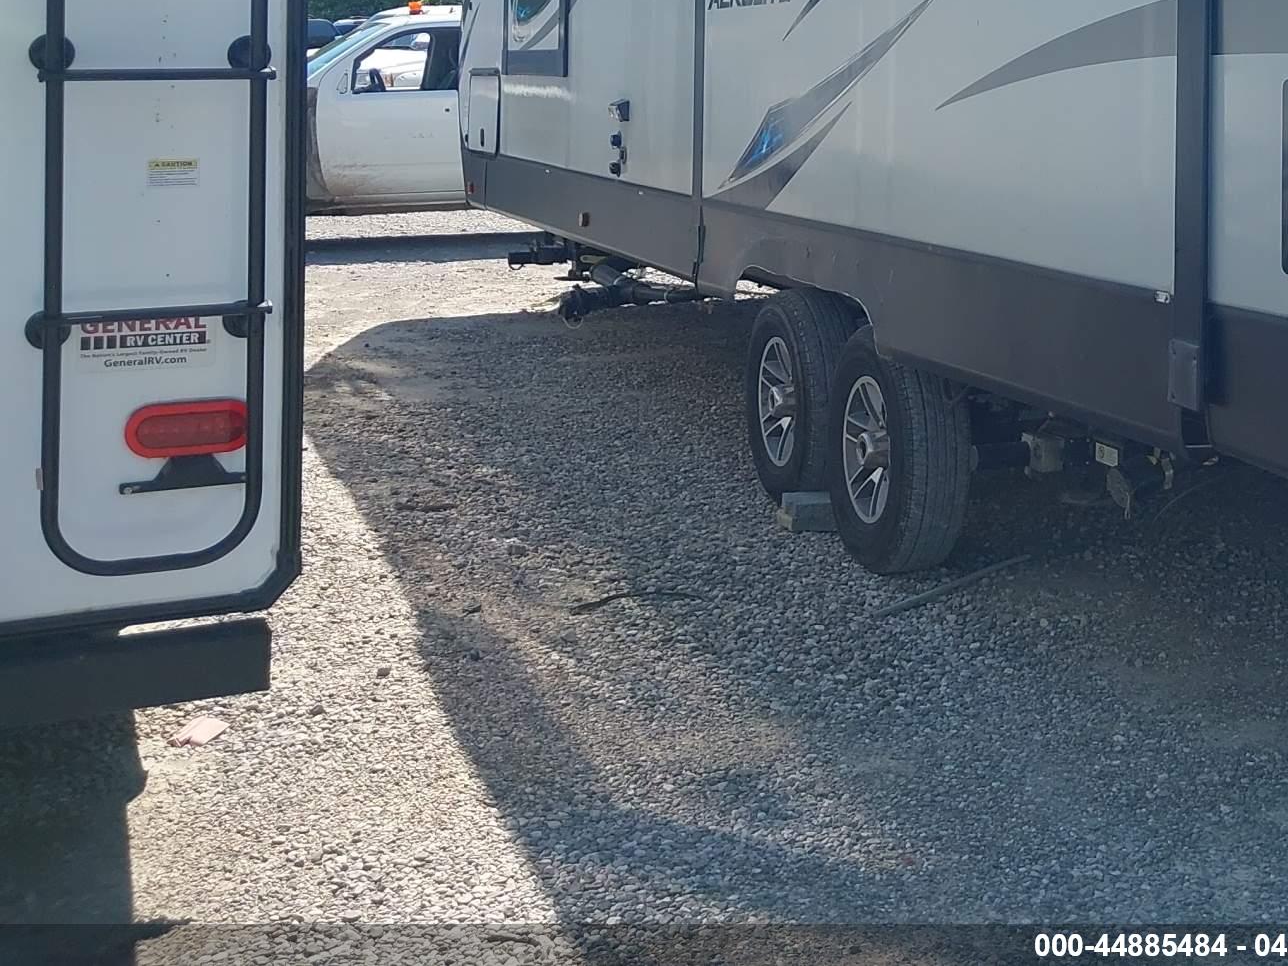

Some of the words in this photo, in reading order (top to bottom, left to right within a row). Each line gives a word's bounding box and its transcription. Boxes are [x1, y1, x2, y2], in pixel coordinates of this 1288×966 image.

[126, 335, 145, 347] RV
[147, 332, 200, 346] CENTER
[103, 356, 187, 368] GeneralRV.com
